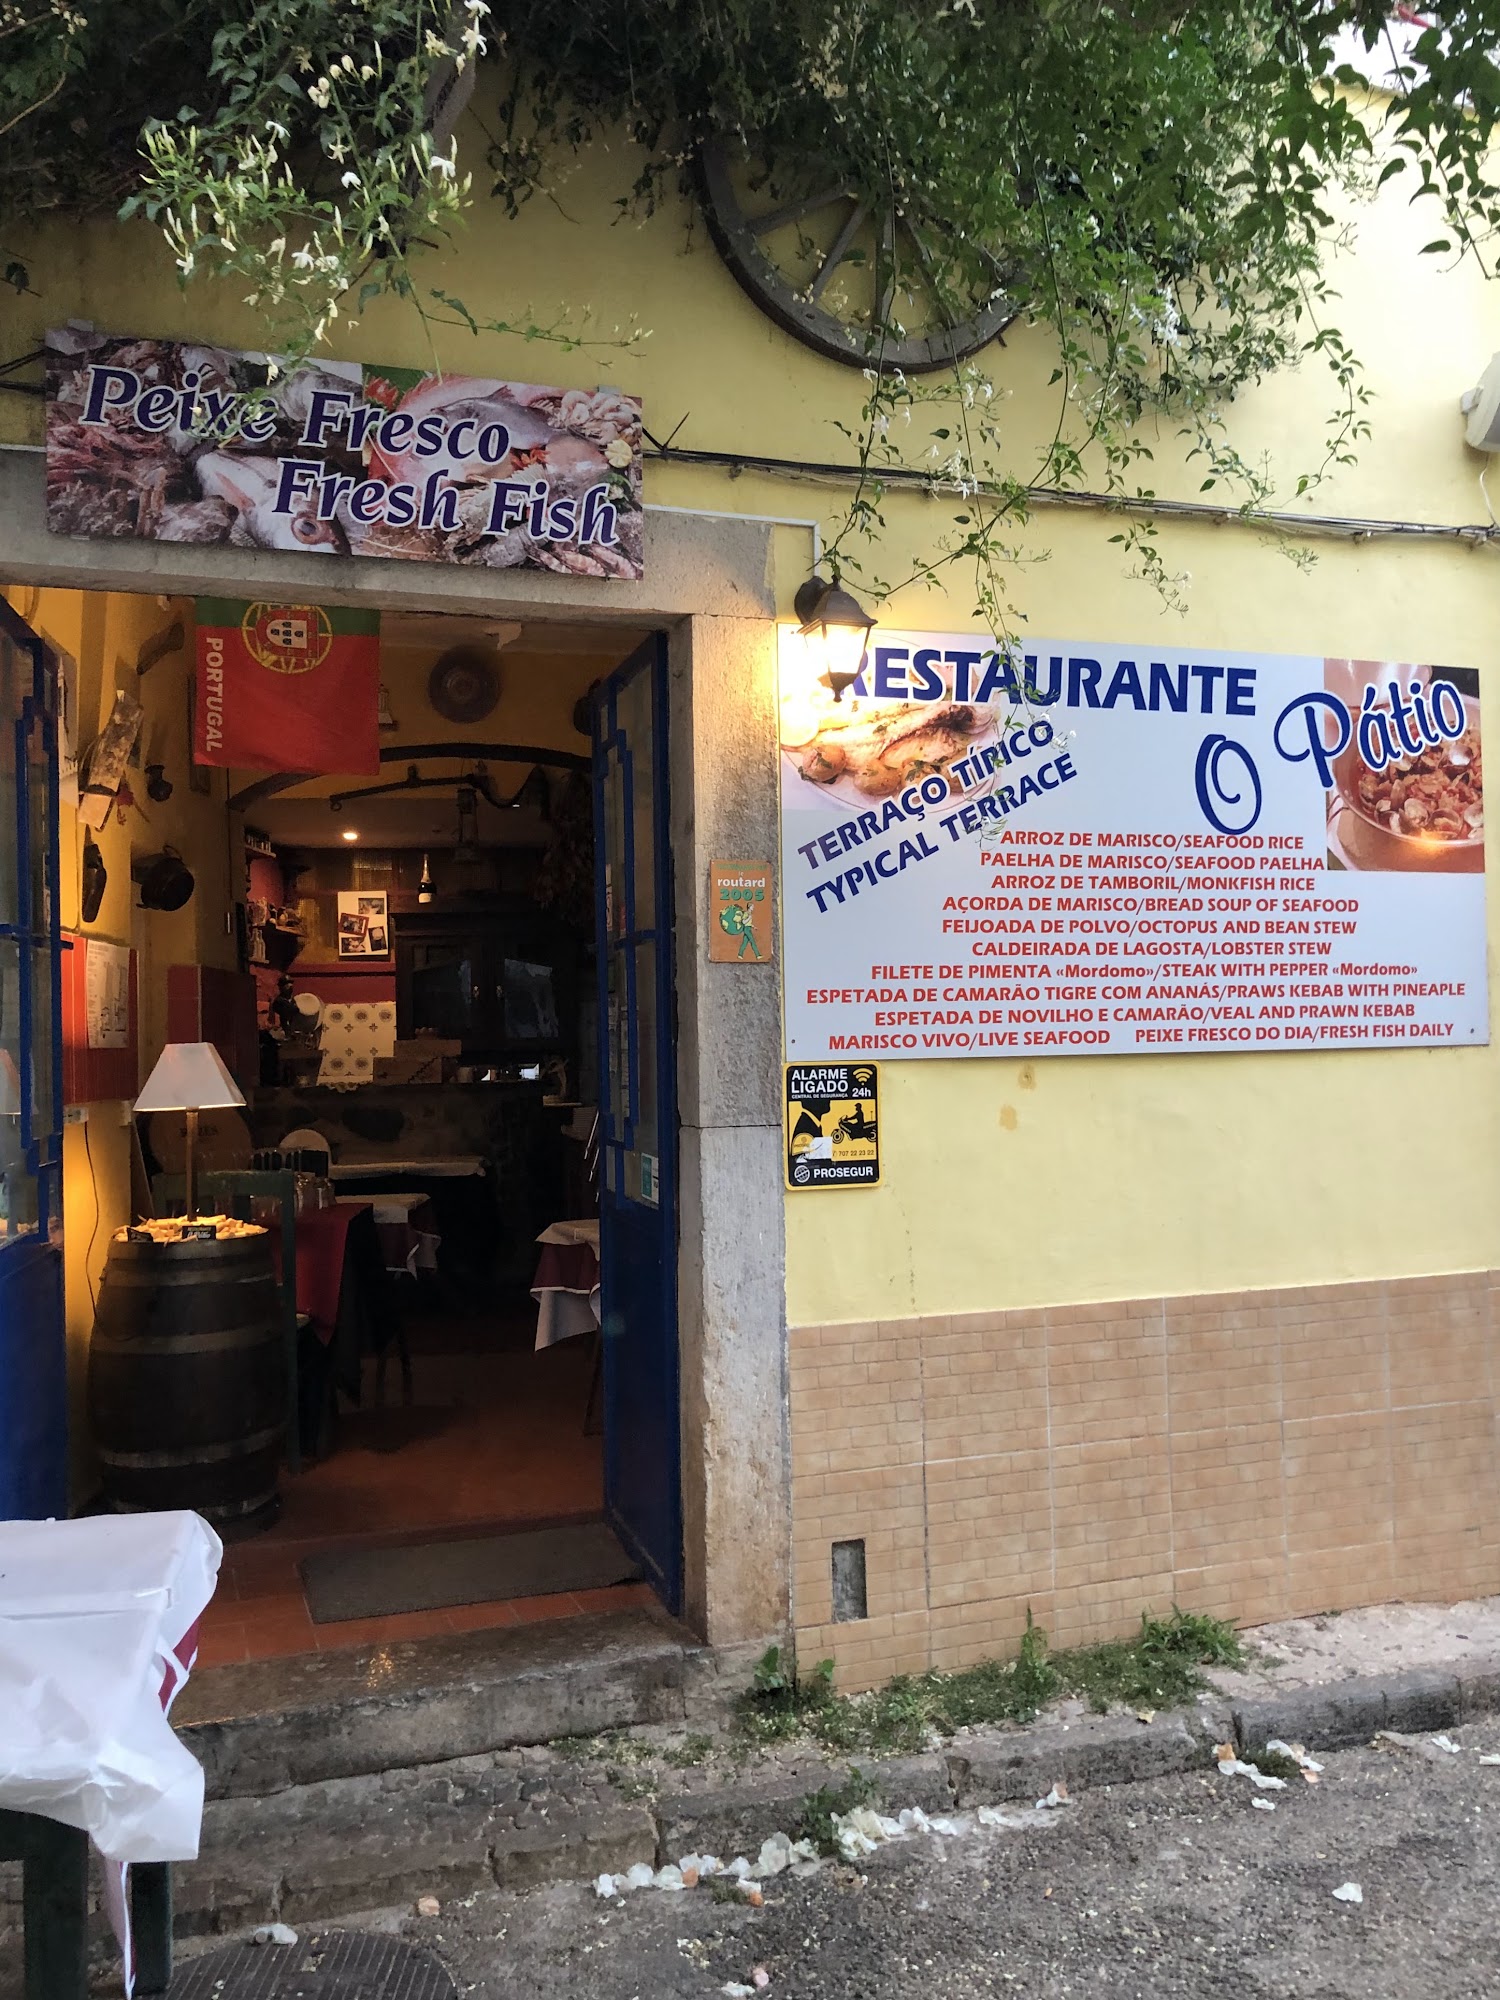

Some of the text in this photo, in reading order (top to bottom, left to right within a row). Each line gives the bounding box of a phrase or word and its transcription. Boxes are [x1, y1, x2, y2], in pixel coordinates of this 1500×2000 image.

[79, 364, 510, 463] Peixe Fresco
[272, 457, 619, 545] Fresh Fish
[206, 637, 223, 751] PORTUGAL
[1195, 681, 1466, 835] O Pátio
[798, 720, 1053, 869] TERRAÇO TÍPICO
[806, 753, 1077, 913] TYPICAL TERRACE
[1000, 830, 1302, 850] ARROZ DE MARISCO/SEAFOOD RICE
[980, 851, 1324, 872] PAELHA DE MARISCO/SEAFOOD PAELHA
[717, 877, 766, 888] routard
[992, 875, 1313, 892] ARROZ DE TAMBORIL/MONKFISH RICE
[720, 888, 765, 901] 2005
[943, 896, 1358, 914] AÇORDA DE MARISCO/BREAD SOUP OF SEAFOOD
[942, 919, 1356, 936] FEIJOADA DE POLVO/OCTOPUS AND BEAN STEW
[972, 942, 1331, 958] CALDEIRADA DE LAGOSTA/LOBSTER STEW
[872, 965, 933, 979] FILETE
[939, 965, 963, 979] DE
[968, 964, 1051, 978] PIMENTA
[1222, 964, 1265, 976] WITH
[1270, 963, 1328, 976] PEPPER
[807, 984, 1464, 1004] ESPETADA DE CAMARÃO TIGRE COM ANANÁS/PRAWS KEBAB WITH PINEAPLE
[875, 1004, 1414, 1026] ESPETADA DE NOVILHO E CAMARÃO/VEAL AND PRAWN KEBAB
[829, 1030, 1110, 1051] MARISCO VIVO/LIVE SEAFOOD
[1136, 1024, 1452, 1042] PEIXE FRESCO DO DIA/FRESH FISH DAILY
[792, 1068, 848, 1081] ALARME
[791, 1080, 872, 1097] LIGADO 24h
[813, 1166, 874, 1178] PROSEGUR
